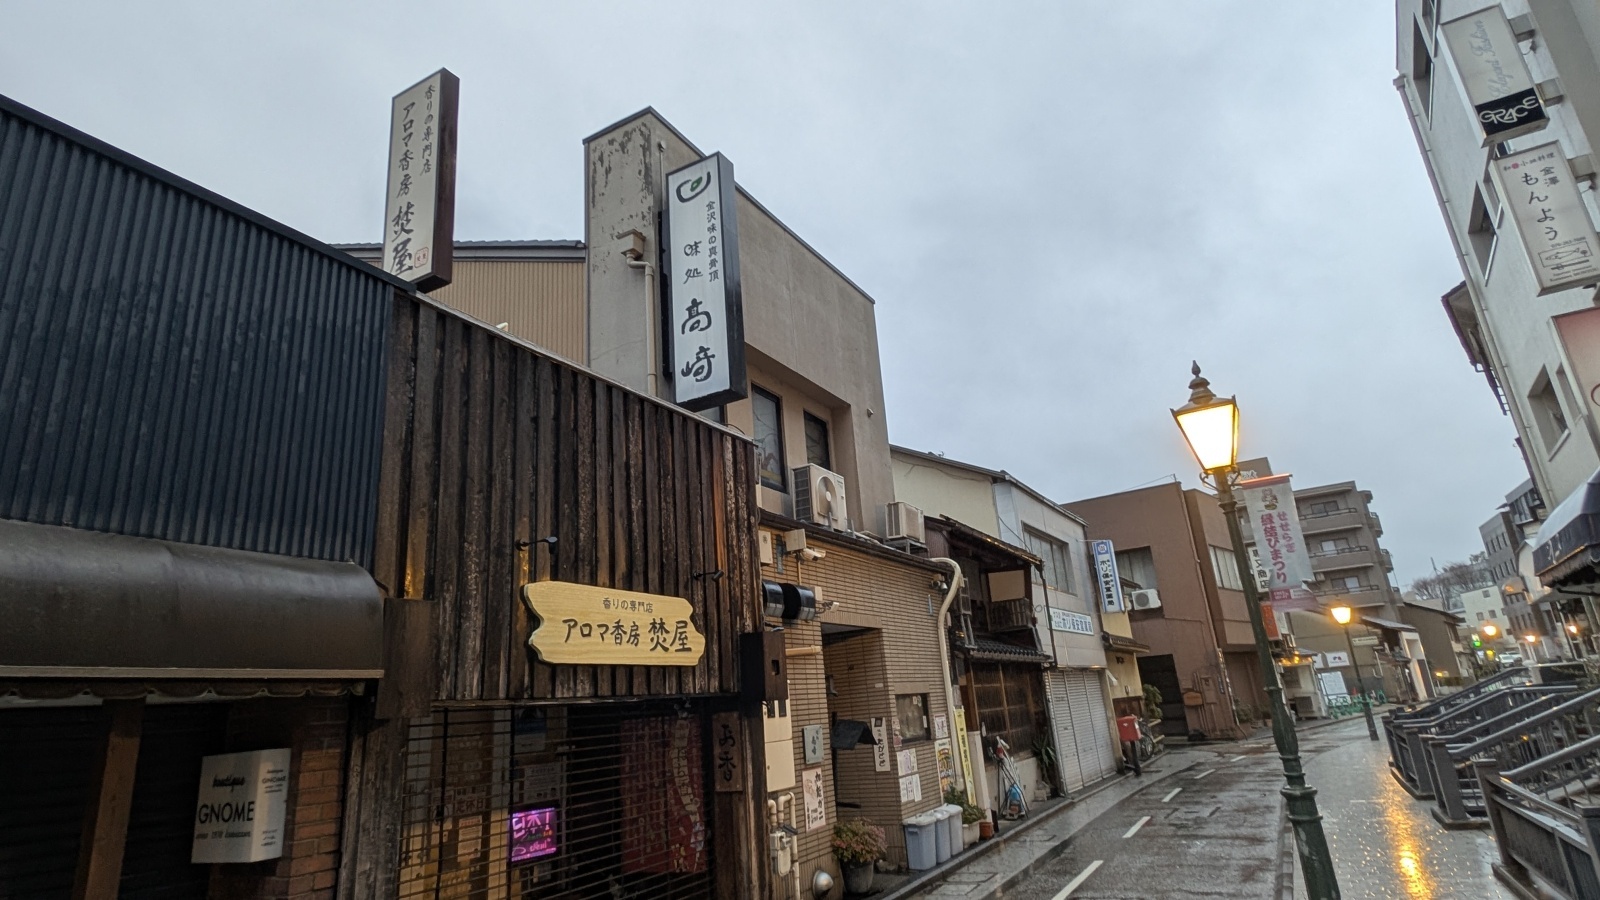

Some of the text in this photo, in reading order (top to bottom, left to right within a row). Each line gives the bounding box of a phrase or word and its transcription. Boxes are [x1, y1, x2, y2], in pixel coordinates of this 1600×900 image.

[420, 84, 435, 176] 香りの専門店
[1479, 95, 1539, 124] GRACE
[1521, 172, 1559, 241] もんよう
[705, 200, 720, 283] 金沢味の真骨頂
[1260, 513, 1287, 584] 縁結びまつり
[1276, 511, 1296, 553] せせらぎ
[602, 597, 654, 614] 香りの専門店
[718, 724, 736, 781] お香
[198, 800, 255, 824] GNOME
